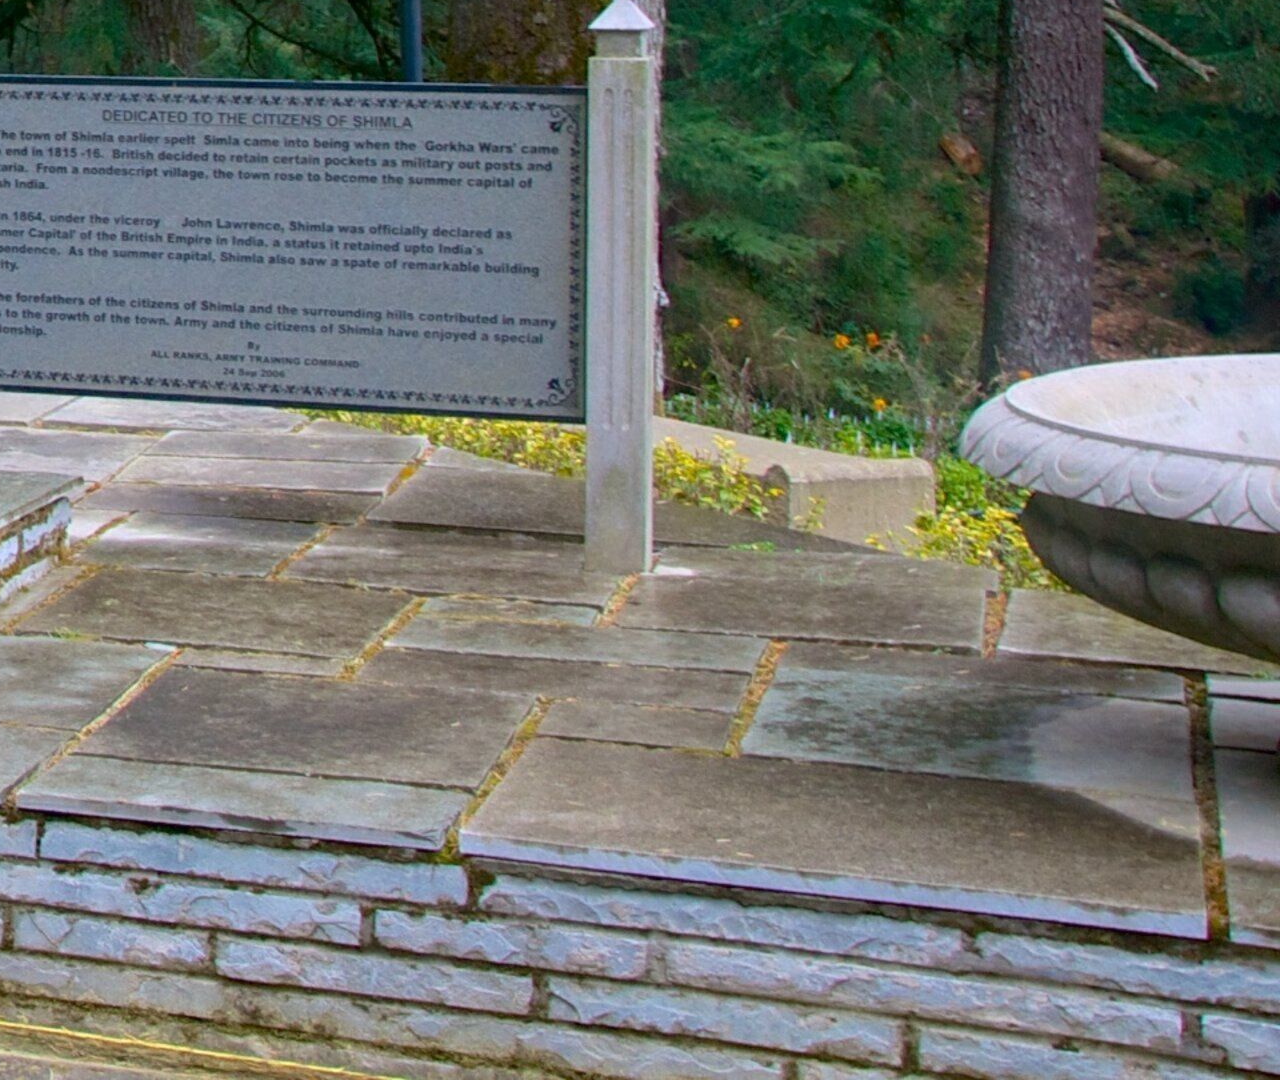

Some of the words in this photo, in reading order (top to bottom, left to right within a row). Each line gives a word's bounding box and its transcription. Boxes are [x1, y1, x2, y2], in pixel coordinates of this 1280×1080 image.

[102, 109, 188, 124] DEDICATED
[192, 111, 213, 125] TO
[217, 112, 246, 125] THE
[251, 113, 321, 127] CITIZENS
[326, 114, 347, 128] OF
[352, 115, 412, 129] SHIMLA
[19, 130, 50, 142] town
[54, 131, 66, 142] of
[71, 131, 114, 144] Shimla
[117, 132, 160, 145] earlier
[163, 133, 195, 148] spelt
[243, 138, 279, 148] came
[283, 136, 309, 149] into
[313, 137, 350, 152] being
[353, 138, 390, 151] when
[393, 139, 416, 151] the
[520, 145, 559, 155] came
[5, 146, 28, 158] end
[31, 146, 43, 158] in
[46, 147, 77, 159] 1815
[112, 148, 153, 161] British
[157, 150, 209, 162] decided
[212, 151, 226, 163] to
[229, 151, 268, 164] retain
[272, 152, 320, 165] certain
[324, 154, 377, 169] pockets
[381, 158, 397, 167] as
[401, 156, 454, 171] military
[457, 157, 480, 169] out
[484, 158, 523, 173] posts
[527, 159, 551, 171] and
[15, 178, 49, 190] India.
[36, 163, 67, 176] From
[71, 167, 79, 176] a
[82, 164, 157, 180] nondescript
[212, 168, 234, 180] the
[237, 169, 270, 181] town
[274, 172, 303, 182] rose
[307, 171, 321, 182] to
[324, 171, 377, 184] become
[382, 173, 403, 185] the
[408, 176, 462, 186] summer
[466, 175, 514, 190] capital
[518, 176, 532, 188] of
[49, 211, 85, 224] under
[88, 213, 110, 225] the
[113, 214, 161, 229] viceroy
[180, 216, 212, 229] John
[215, 217, 284, 233] Lawrence,
[288, 220, 334, 233] Shimla
[337, 224, 365, 234] was
[368, 223, 428, 239] officially
[432, 225, 492, 239] declared
[495, 230, 512, 240] as
[79, 229, 92, 241] of
[96, 229, 116, 242] the
[120, 230, 162, 243] British
[167, 232, 212, 247] Empire
[216, 234, 228, 246] in
[272, 238, 280, 248] a
[284, 236, 325, 249] status
[330, 238, 339, 250] it
[343, 238, 400, 252] retained
[404, 241, 434, 256] upto
[68, 245, 83, 257] As
[87, 246, 108, 258] the
[112, 249, 163, 260] summer
[220, 251, 264, 264] Shimla
[268, 253, 295, 265] also
[300, 257, 326, 267] saw
[330, 258, 339, 267] a
[342, 256, 379, 271] spate
[384, 257, 397, 269] of
[402, 258, 480, 272] remarkable
[484, 261, 540, 277] building
[16, 291, 84, 306] forefathers
[88, 295, 101, 307] of
[105, 295, 125, 308] the
[130, 296, 179, 310] citizens
[183, 299, 196, 311] of
[200, 300, 244, 313] Shimla
[249, 302, 272, 314] and
[277, 303, 297, 315] the
[302, 304, 382, 321] surrounding
[386, 308, 413, 321] hills
[418, 309, 498, 324] contributed
[502, 313, 514, 325] in
[519, 316, 556, 329] many
[5, 308, 18, 320] to
[21, 308, 42, 321] the
[45, 310, 90, 325] growth
[93, 312, 106, 324] of
[110, 313, 130, 325] the
[173, 316, 207, 331] Army
[211, 317, 236, 330] and
[239, 319, 260, 331] the
[263, 320, 316, 334] citizens
[320, 322, 333, 335] of
[338, 323, 383, 337] Shimla
[387, 326, 419, 339] have
[423, 327, 476, 344] enjoyed
[480, 333, 489, 342] a
[493, 331, 542, 347] special
[151, 350, 169, 360] ALL
[214, 353, 244, 364] ARMY
[249, 355, 300, 366] TRAINING
[304, 357, 359, 369] COMMAND
